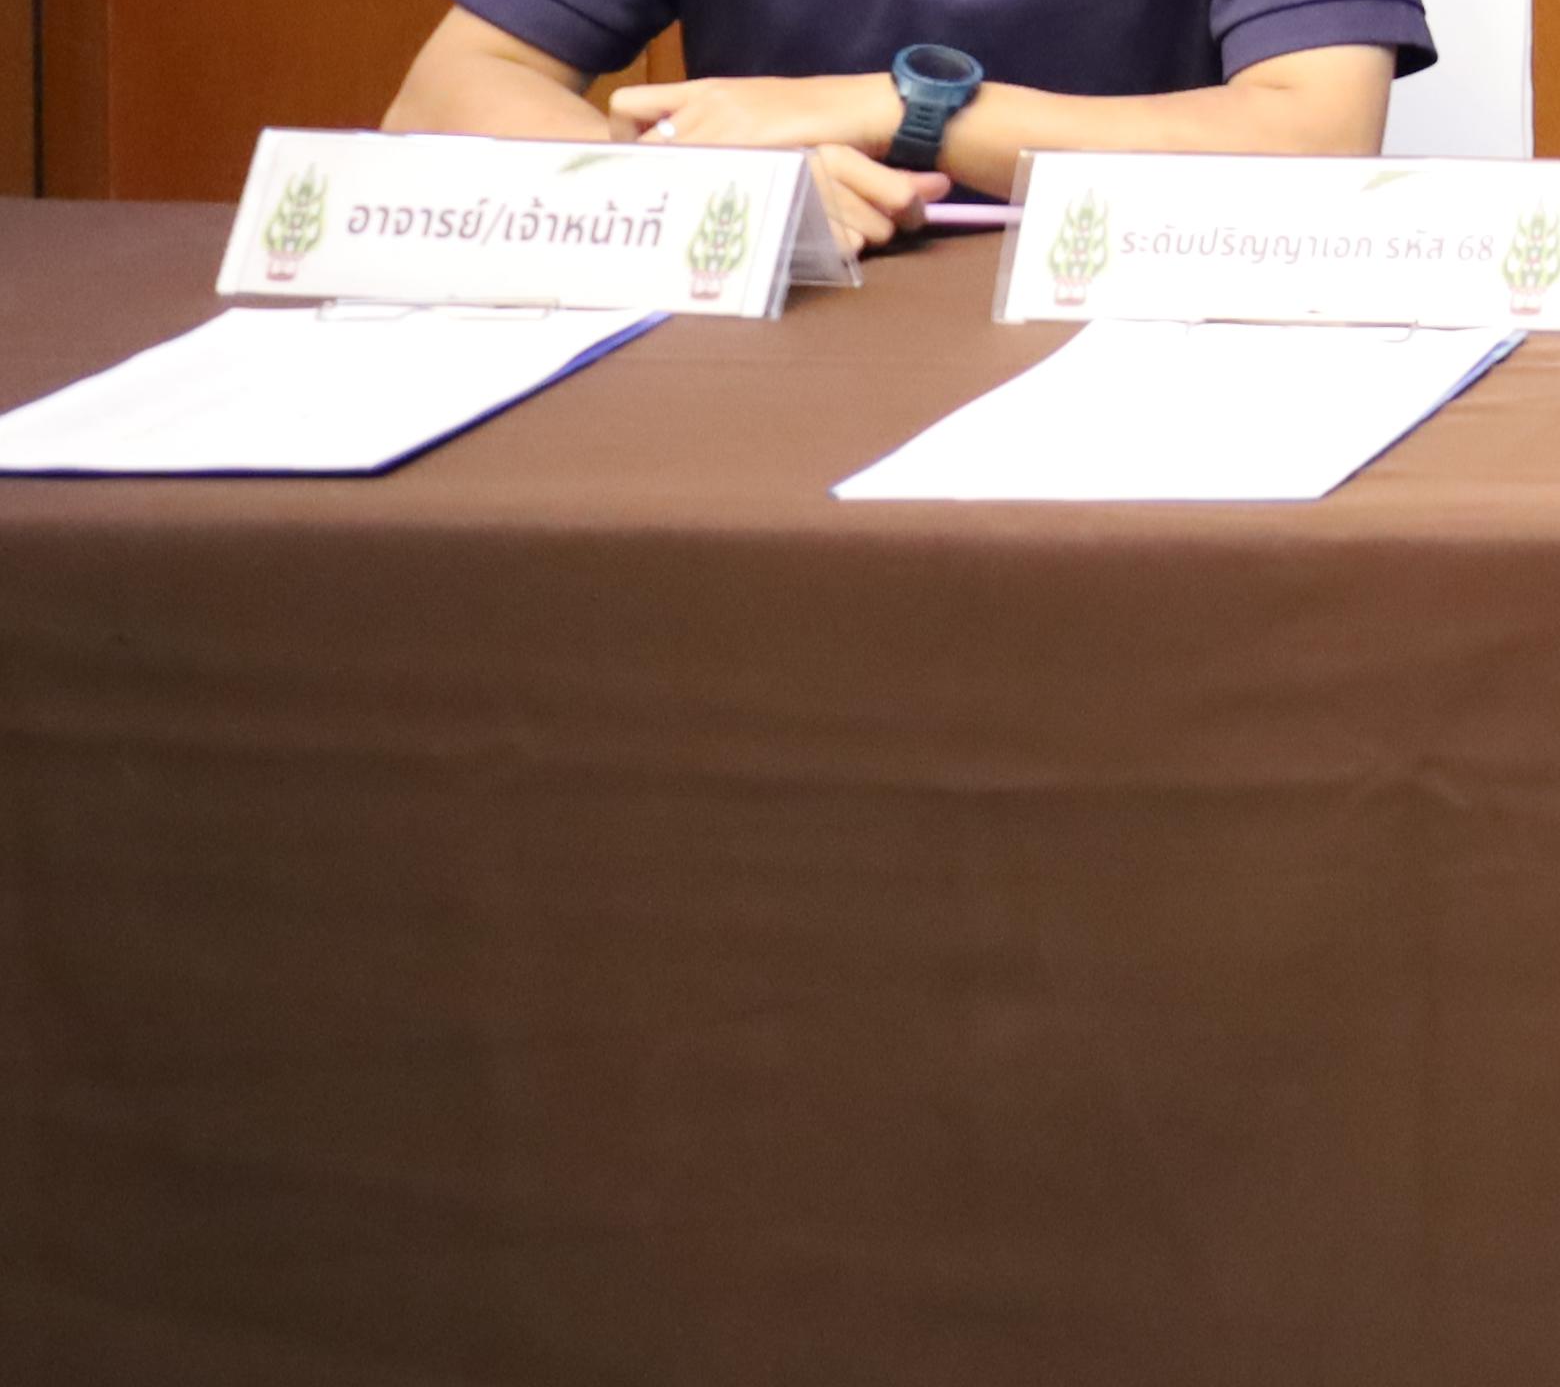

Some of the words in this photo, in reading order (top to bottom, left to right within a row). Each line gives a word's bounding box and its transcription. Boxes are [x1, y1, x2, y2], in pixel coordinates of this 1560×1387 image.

[346, 192, 668, 249] อาจารย์/เจ้าหน้าที่
[1456, 234, 1496, 263] 68
